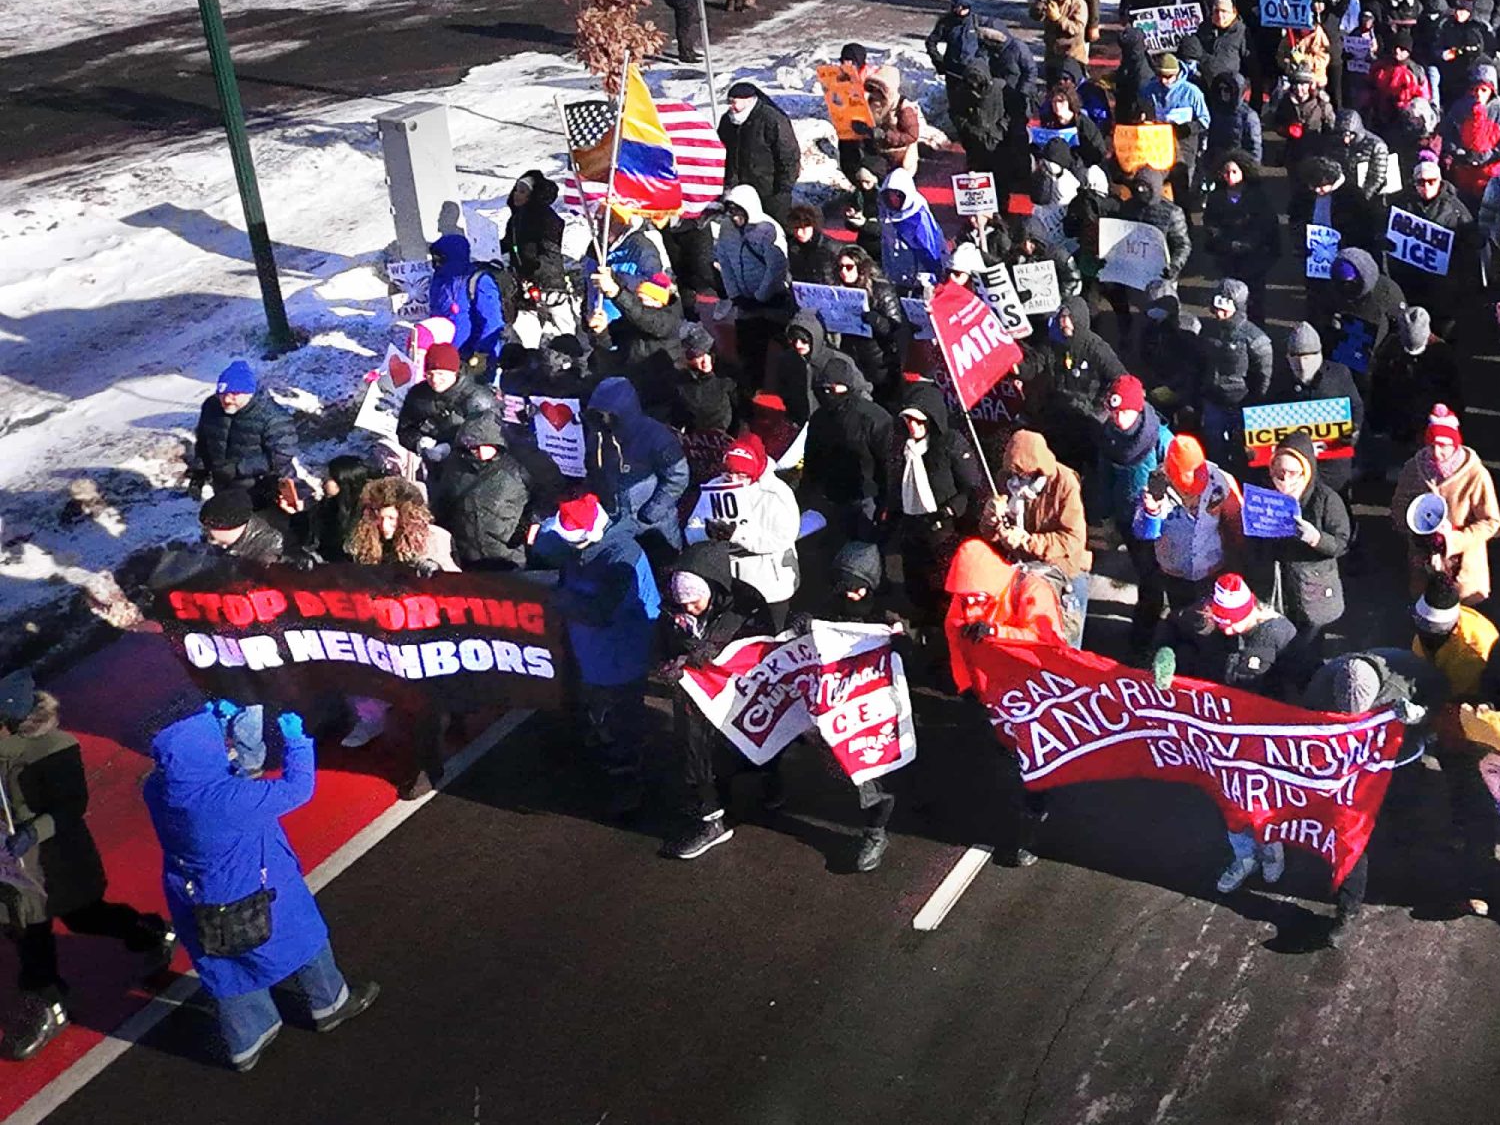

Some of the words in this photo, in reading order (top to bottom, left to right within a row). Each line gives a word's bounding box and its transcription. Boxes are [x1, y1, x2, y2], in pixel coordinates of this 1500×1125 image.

[1158, 6, 1198, 24] BLAME
[1263, 1, 1308, 22] OUT!
[1401, 238, 1438, 272] ICE
[1247, 426, 1288, 446] ICE
[709, 491, 739, 519] NO
[169, 588, 289, 628] STOP
[295, 589, 545, 635] DEPORTING
[184, 629, 283, 671] OUR
[284, 628, 555, 679] NEIGHBORS
